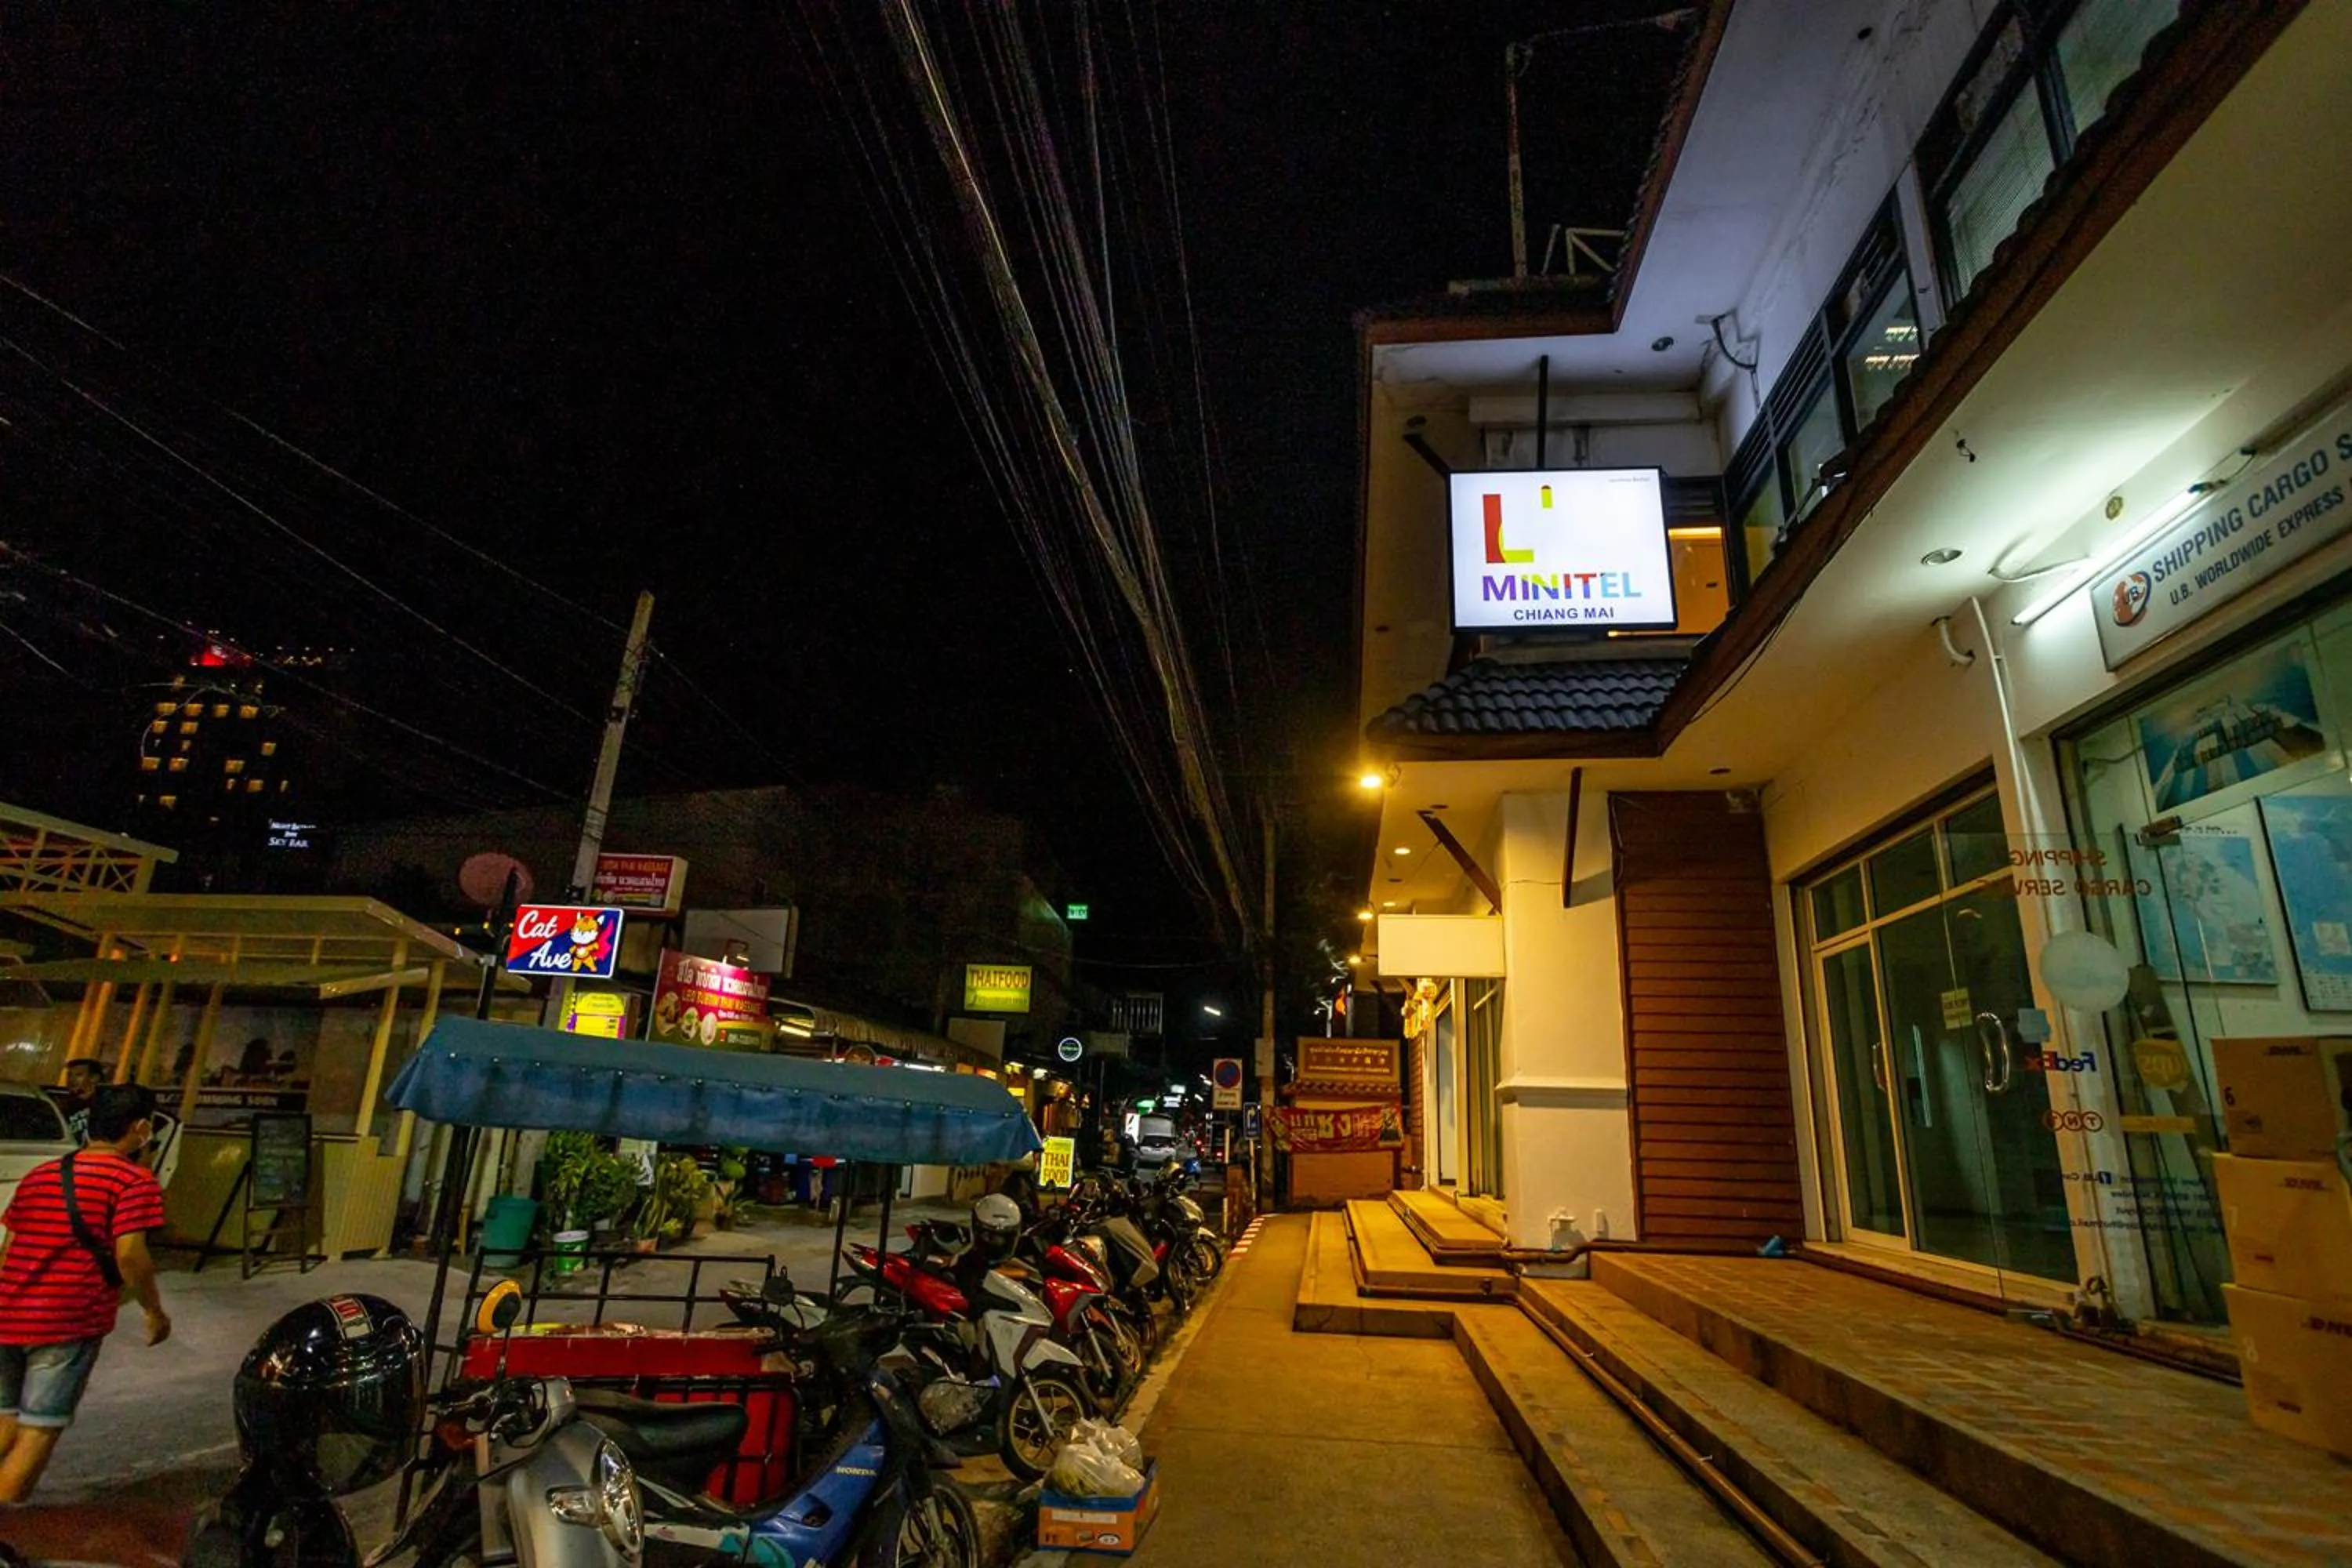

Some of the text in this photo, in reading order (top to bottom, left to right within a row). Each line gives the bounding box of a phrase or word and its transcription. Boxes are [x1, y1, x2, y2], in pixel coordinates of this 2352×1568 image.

[2152, 507, 2243, 583] SHIPPING
[2248, 450, 2328, 519] CARGO
[2170, 486, 2345, 605] U.B. WORLDWIDE EXPRESS
[1482, 572, 1642, 601] MINITEL
[1513, 607, 1615, 621] CHIANG MAI
[517, 909, 558, 939] Cat
[528, 940, 572, 969] Ave
[1044, 1152, 1069, 1167] THAI
[1044, 1168, 1069, 1184] FOOD
[836, 1466, 877, 1476] HONDA
